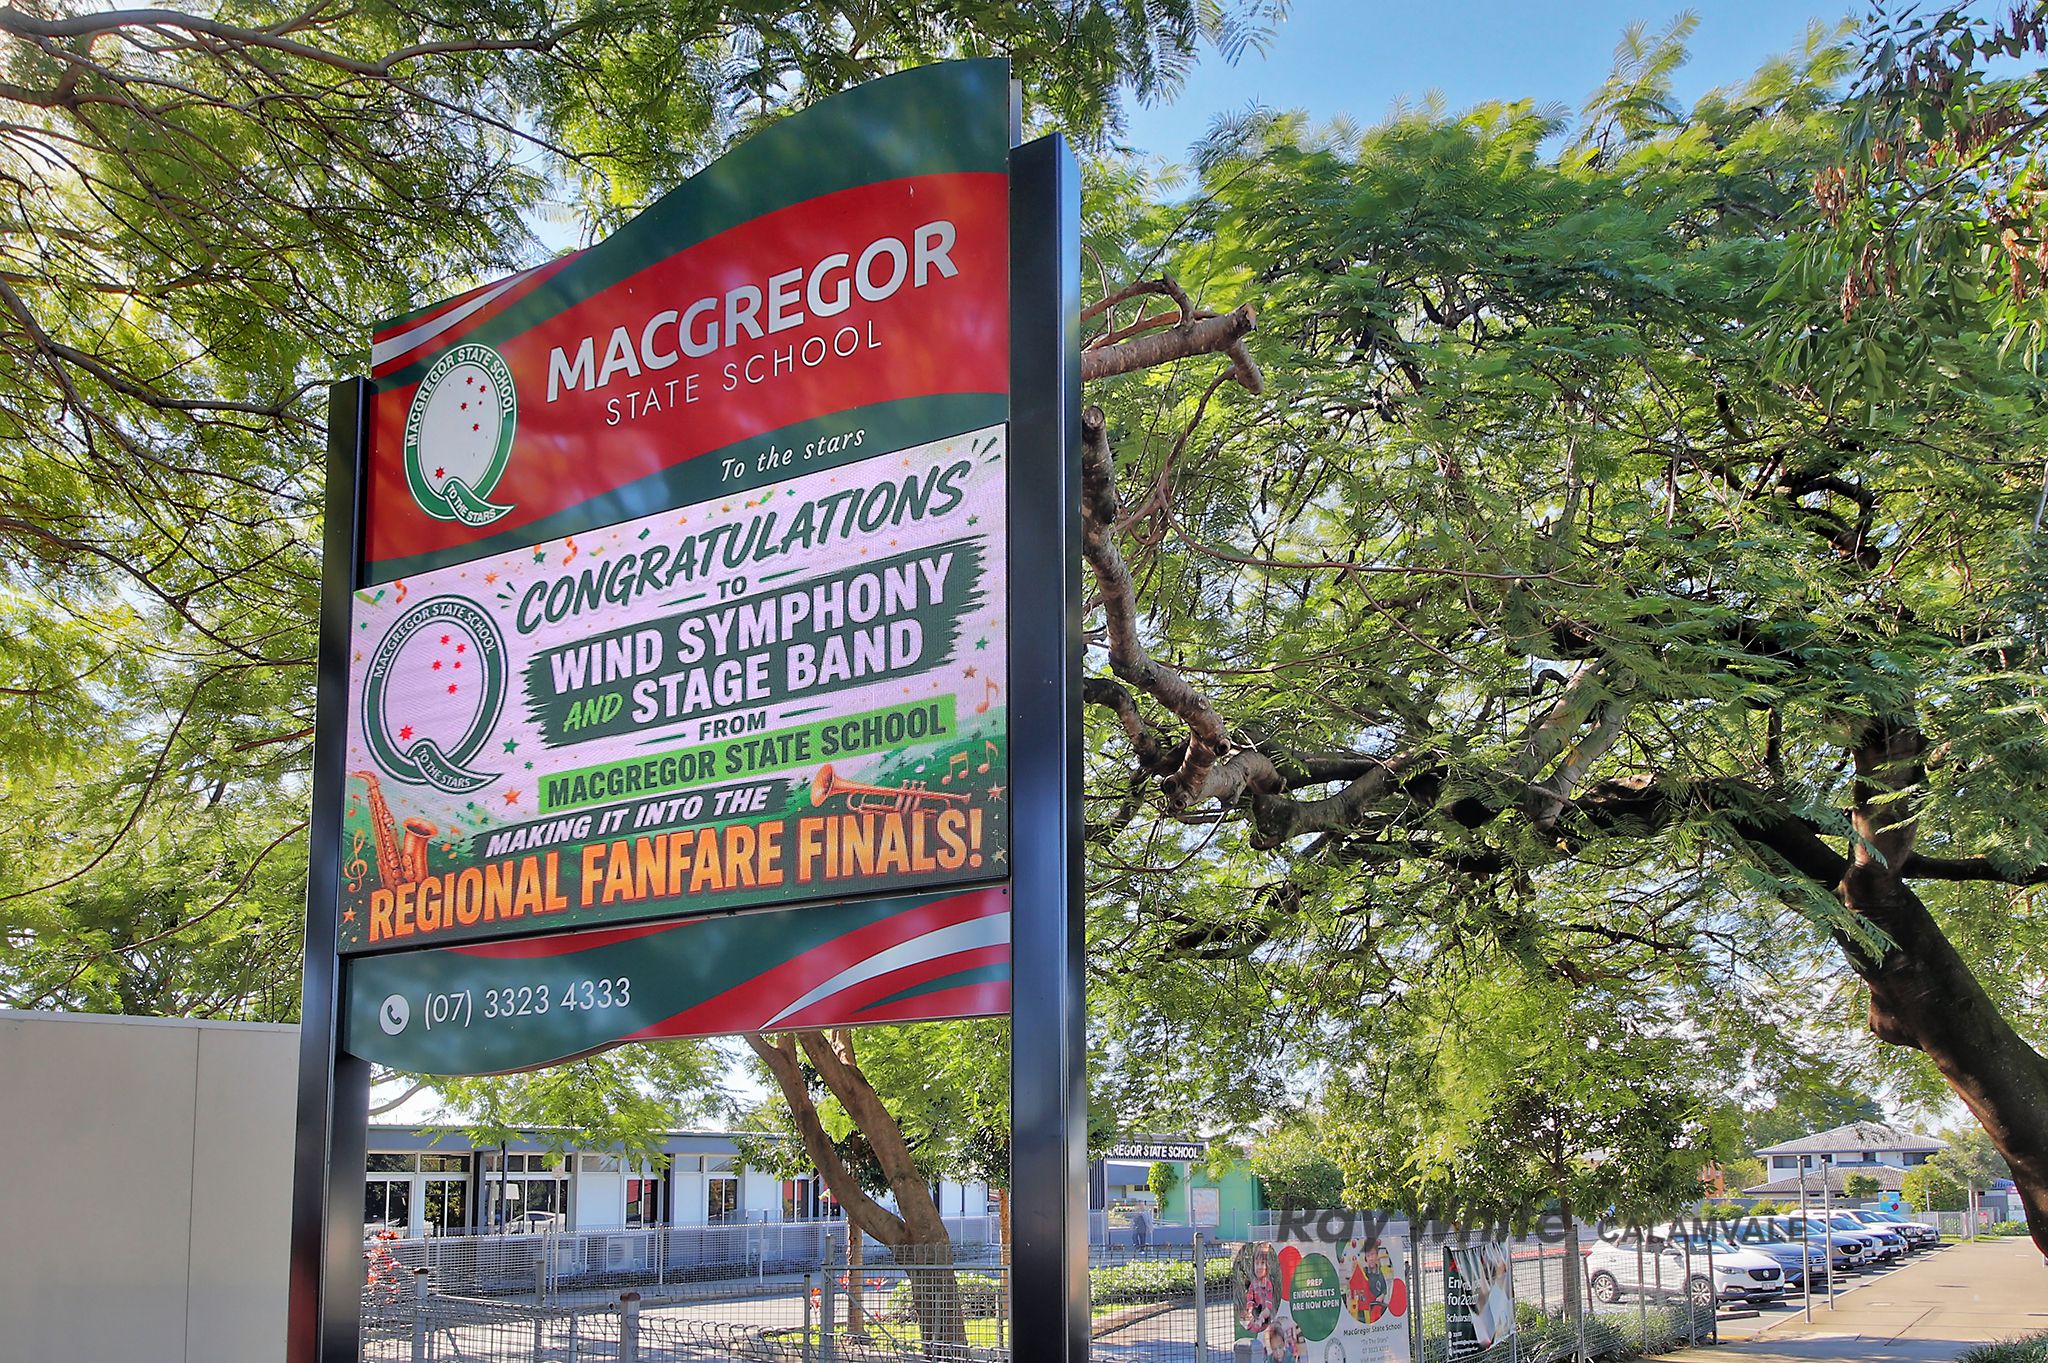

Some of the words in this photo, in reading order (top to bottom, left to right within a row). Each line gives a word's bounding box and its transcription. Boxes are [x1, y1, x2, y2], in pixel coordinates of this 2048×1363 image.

[547, 220, 960, 403] MACGREGOR
[407, 354, 455, 447] MACGREGOR
[457, 347, 494, 367] STATE
[489, 359, 514, 418] SCHOOL
[605, 373, 700, 426] STATE
[722, 320, 882, 392] SCHOOL
[721, 457, 746, 483] To
[756, 445, 793, 473] the
[803, 428, 866, 461] stars
[446, 483, 458, 500] TO
[455, 497, 470, 517] THE
[465, 508, 496, 523] STARS
[516, 460, 972, 634] CONGRATULATIONS
[717, 576, 748, 601] TO
[373, 608, 431, 679] MACGREGOR
[431, 603, 465, 618] STATE
[464, 611, 497, 655] SCHOOL
[548, 628, 665, 695] WIND
[676, 551, 955, 666] SYMPHONY
[562, 692, 624, 733] AND
[630, 652, 772, 725] STAGE
[786, 617, 924, 691] BAND
[699, 711, 766, 741] FROM
[417, 747, 429, 764] TO
[425, 760, 442, 780] THE
[441, 775, 471, 788] STARS
[547, 749, 717, 808] MACGREGOR
[725, 730, 811, 774] STATE
[821, 704, 947, 756] SCHOOL
[484, 813, 593, 859] MAKING
[598, 807, 629, 834] IT
[633, 795, 705, 830] INTO
[713, 785, 773, 817] THE
[368, 852, 569, 944] REGIONAL
[580, 819, 786, 910] FANFARE
[797, 807, 984, 886] FINALS!
[424, 989, 473, 1031] (07)
[483, 984, 550, 1020] 3323
[560, 976, 631, 1012] 4333
[1143, 1145, 1168, 1158] STATE
[1168, 1145, 1199, 1159] SCHOOL
[1292, 1288, 1336, 1300] ENROLMENTS
[1292, 1302, 1305, 1311] ARE
[1305, 1301, 1321, 1310] NOW
[1321, 1299, 1340, 1308] OPEN
[1306, 1278, 1324, 1287] PREP
[1343, 1327, 1371, 1336] MacGregor
[1371, 1325, 1385, 1333] State
[1385, 1322, 1403, 1331] School
